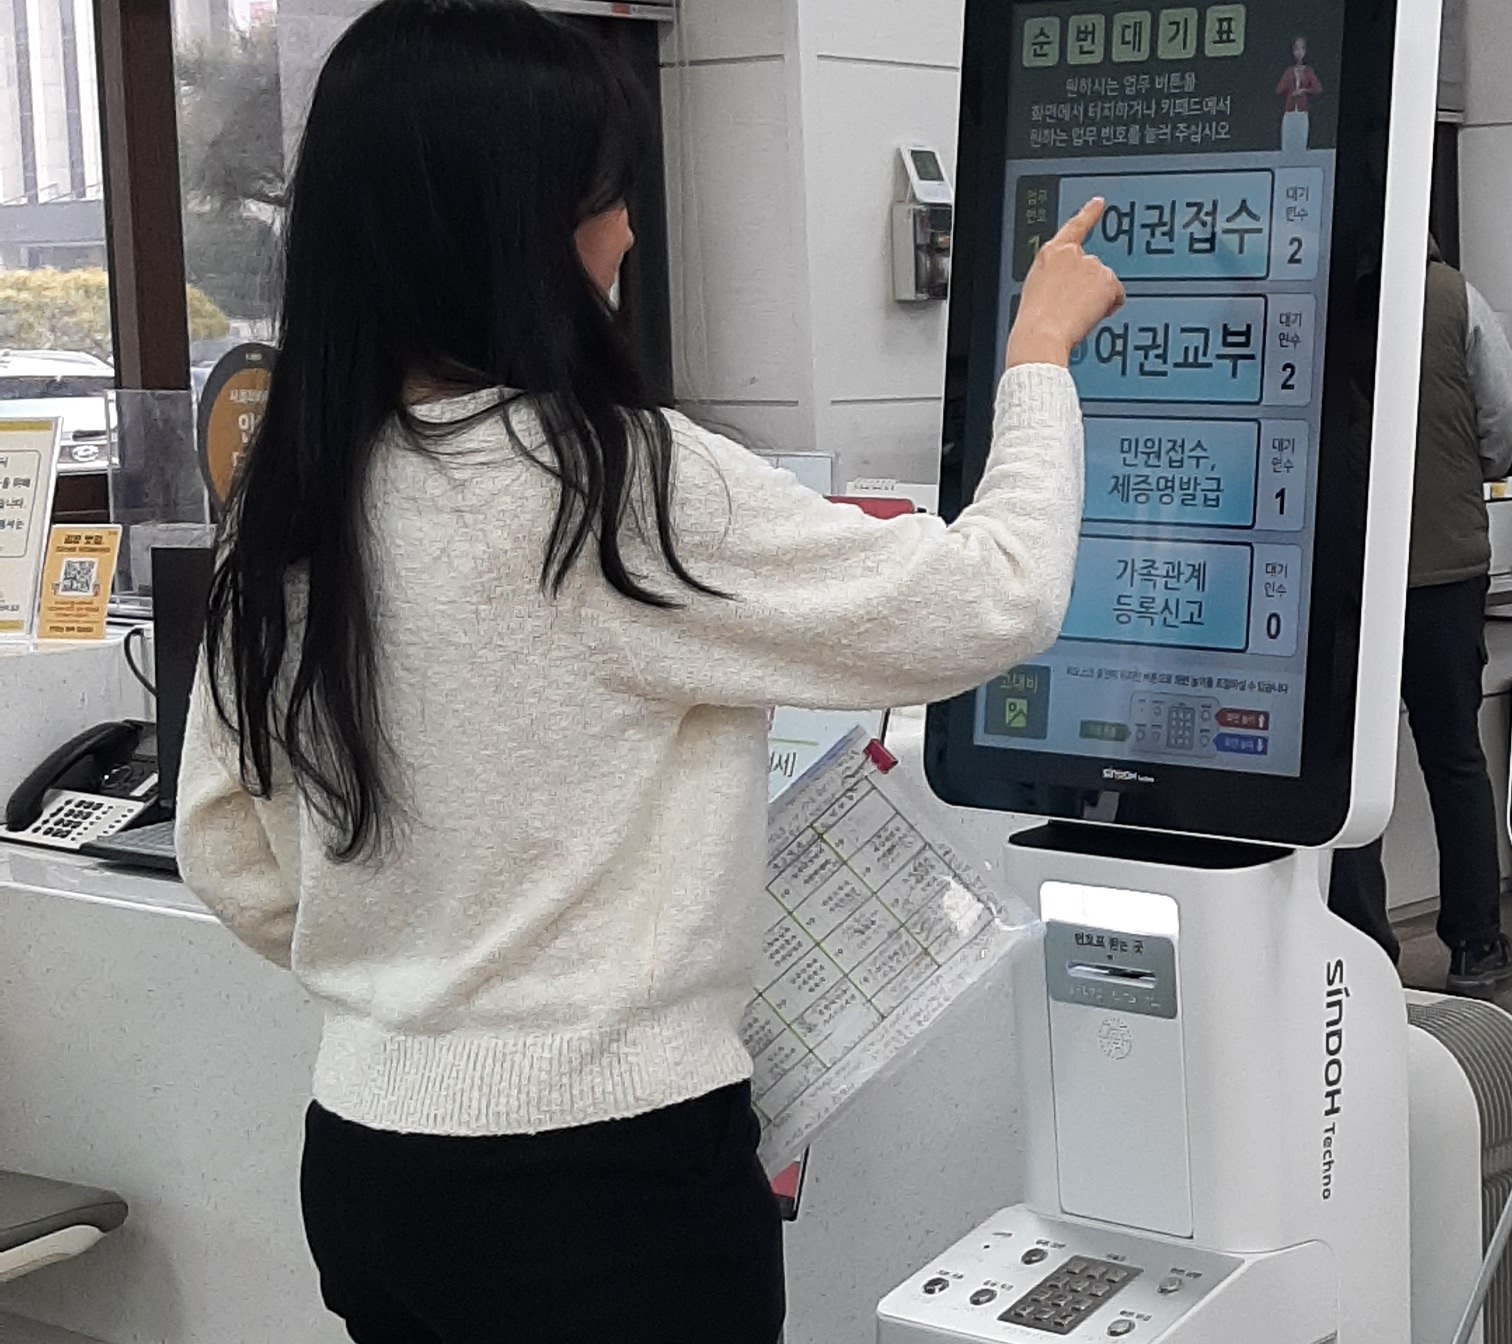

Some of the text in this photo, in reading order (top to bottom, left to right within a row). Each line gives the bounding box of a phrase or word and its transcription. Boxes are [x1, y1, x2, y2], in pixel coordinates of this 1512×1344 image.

[1102, 199, 1263, 256] 여권접수
[1287, 237, 1303, 265] 2
[1095, 322, 1256, 379] 여권교부
[1280, 363, 1296, 390] 2
[1120, 437, 1216, 471] 민원접수,
[1109, 474, 1225, 508] 제증명발급
[1275, 487, 1286, 515] 1
[1115, 558, 1206, 592] 가족관계
[1112, 594, 1204, 628] 등록신고
[1266, 612, 1281, 639] 0
[1322, 1121, 1335, 1200] Techno
